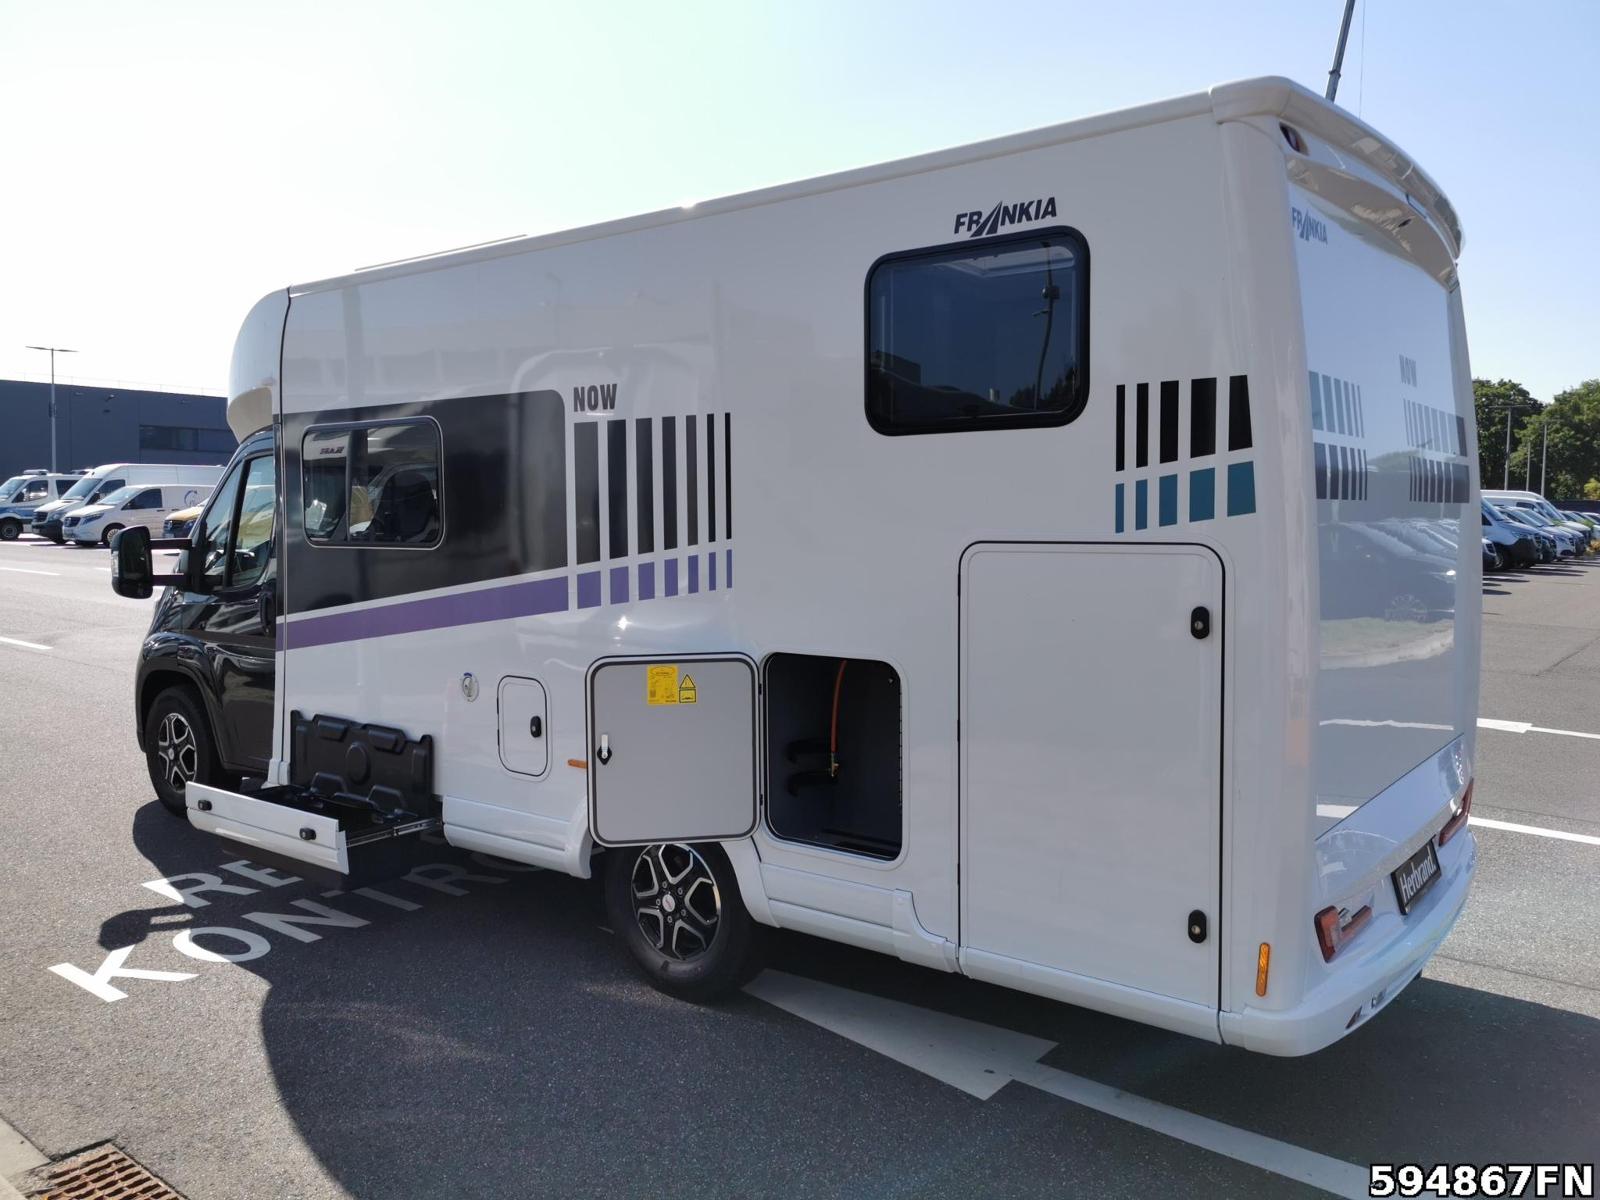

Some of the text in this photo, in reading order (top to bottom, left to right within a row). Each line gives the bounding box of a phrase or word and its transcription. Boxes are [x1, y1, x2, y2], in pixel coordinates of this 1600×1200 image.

[953, 196, 1058, 238] FRANKIA
[1291, 206, 1328, 245] FRANKIA
[573, 383, 617, 412] NOW
